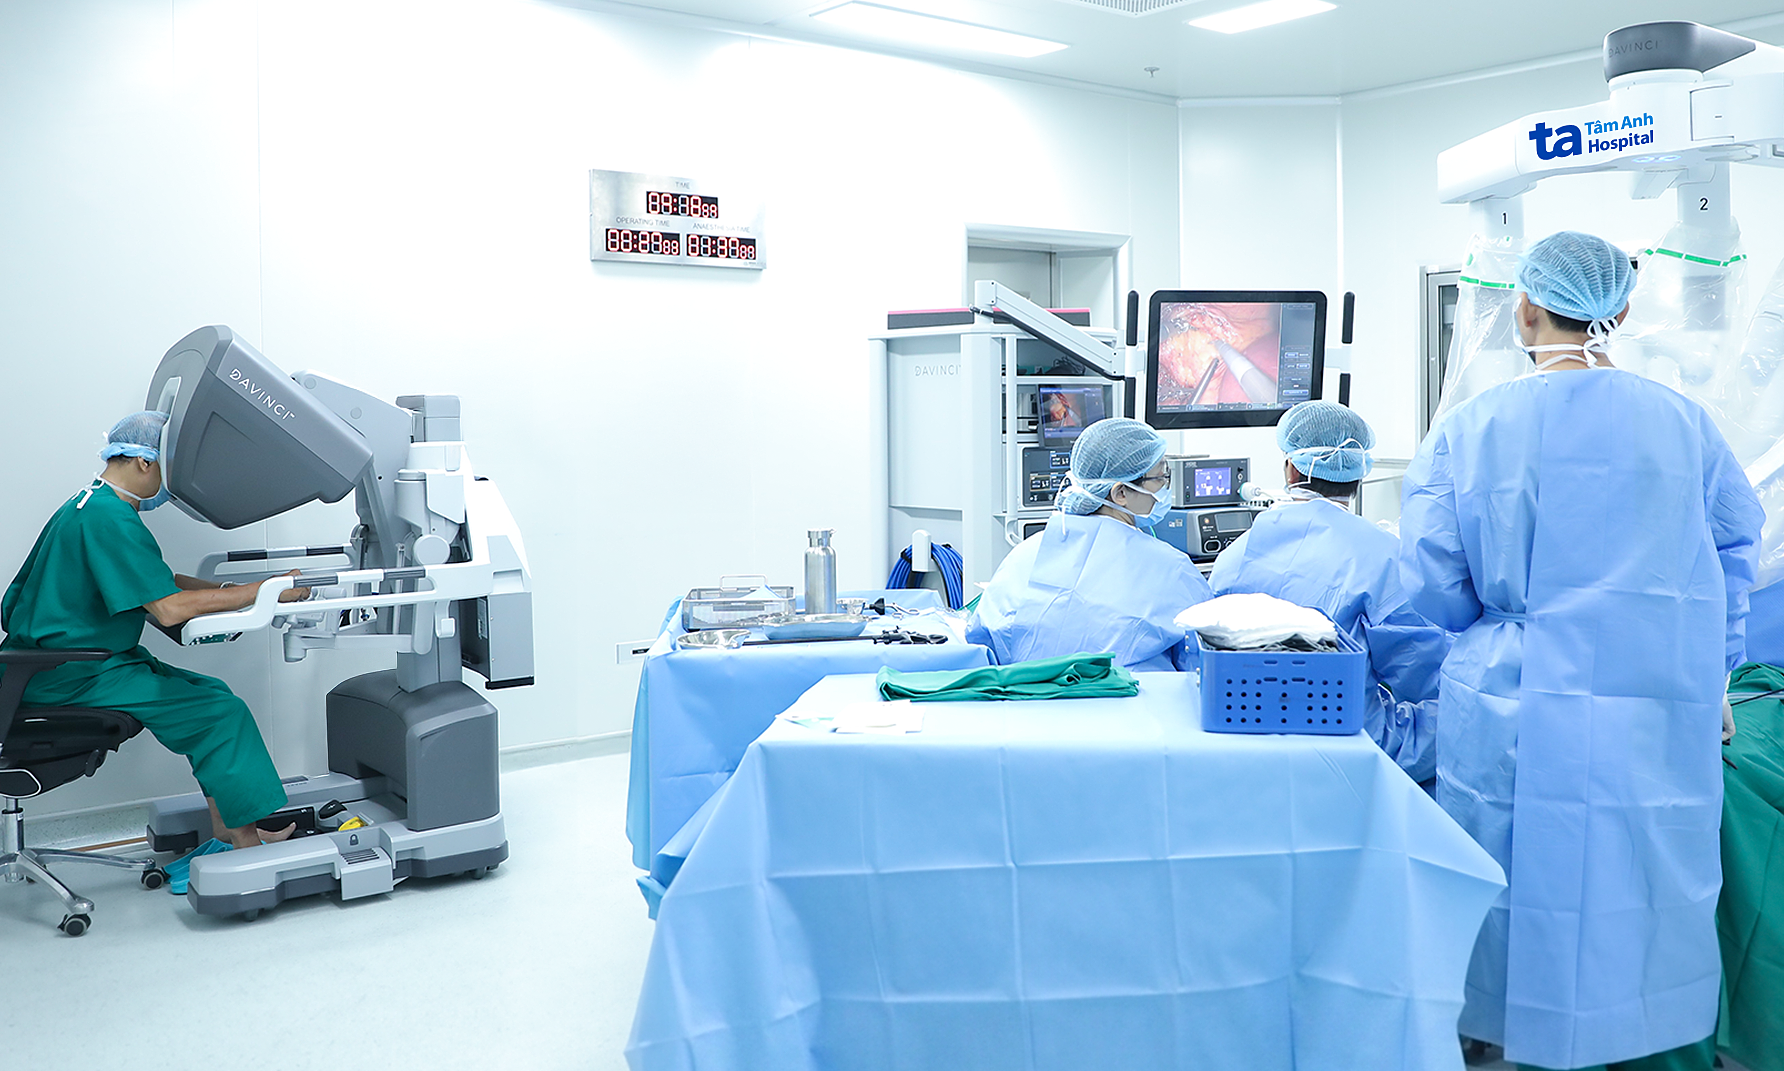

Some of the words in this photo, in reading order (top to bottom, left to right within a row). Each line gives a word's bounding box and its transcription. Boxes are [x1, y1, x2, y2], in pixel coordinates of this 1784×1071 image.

[1608, 40, 1659, 58] DAVINCI
[1699, 197, 1709, 211] 2
[616, 216, 653, 226] OPERATING
[655, 219, 670, 227] TIME
[1502, 212, 1507, 225] 1
[915, 364, 959, 377] DAVINCI
